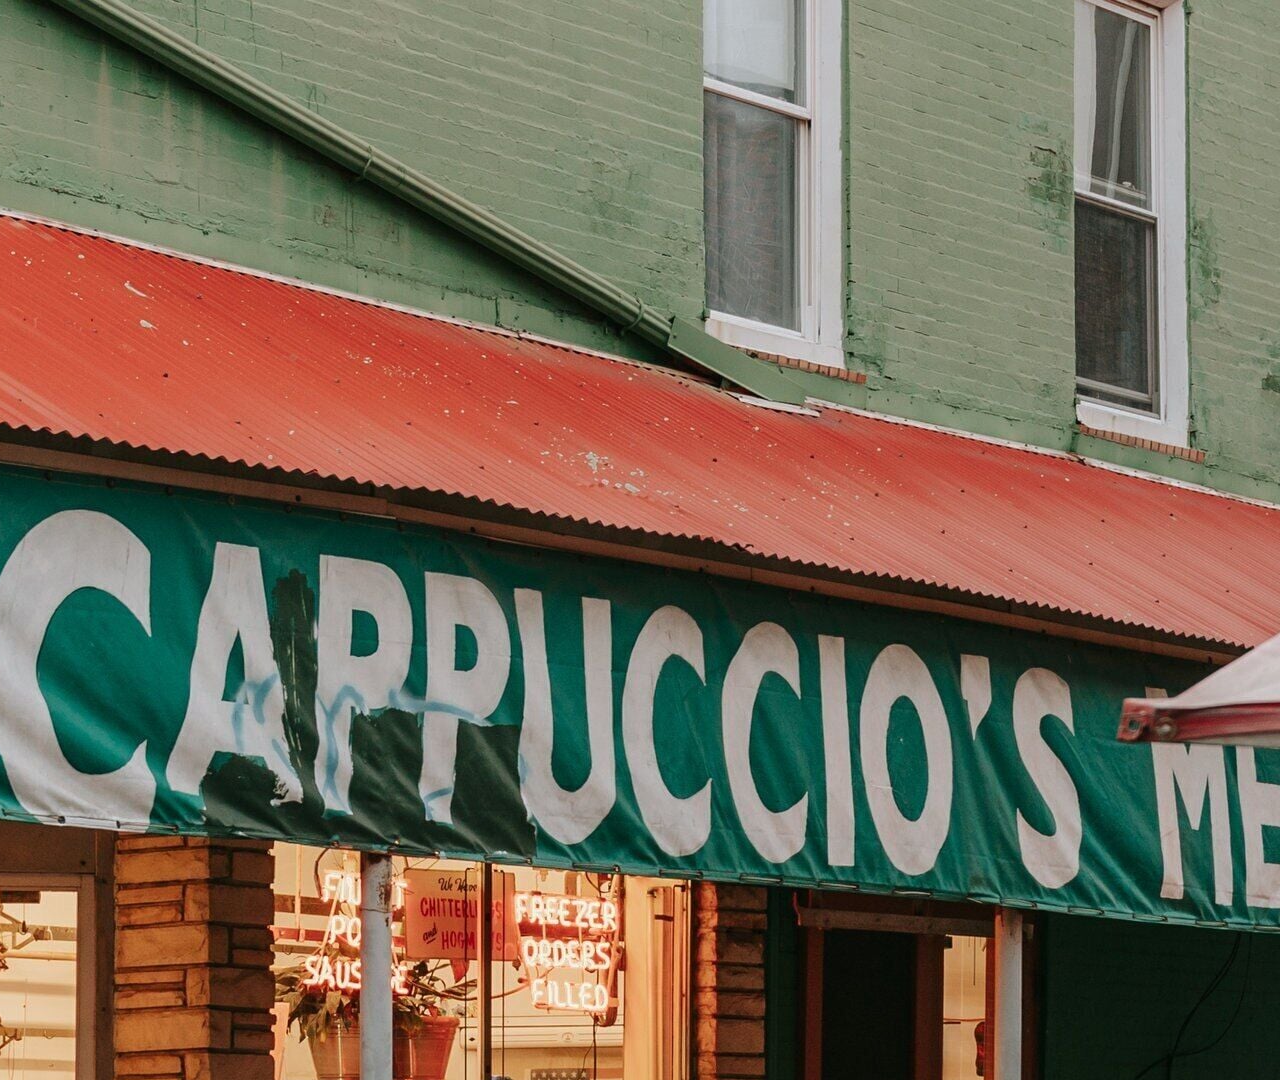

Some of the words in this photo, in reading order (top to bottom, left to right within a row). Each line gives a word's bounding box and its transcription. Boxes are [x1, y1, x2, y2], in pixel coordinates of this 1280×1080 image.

[438, 877, 453, 891] We
[514, 893, 617, 932] FREEZER
[422, 922, 438, 943] and
[522, 938, 612, 971] ORDERS
[531, 978, 609, 1013] FILLED
